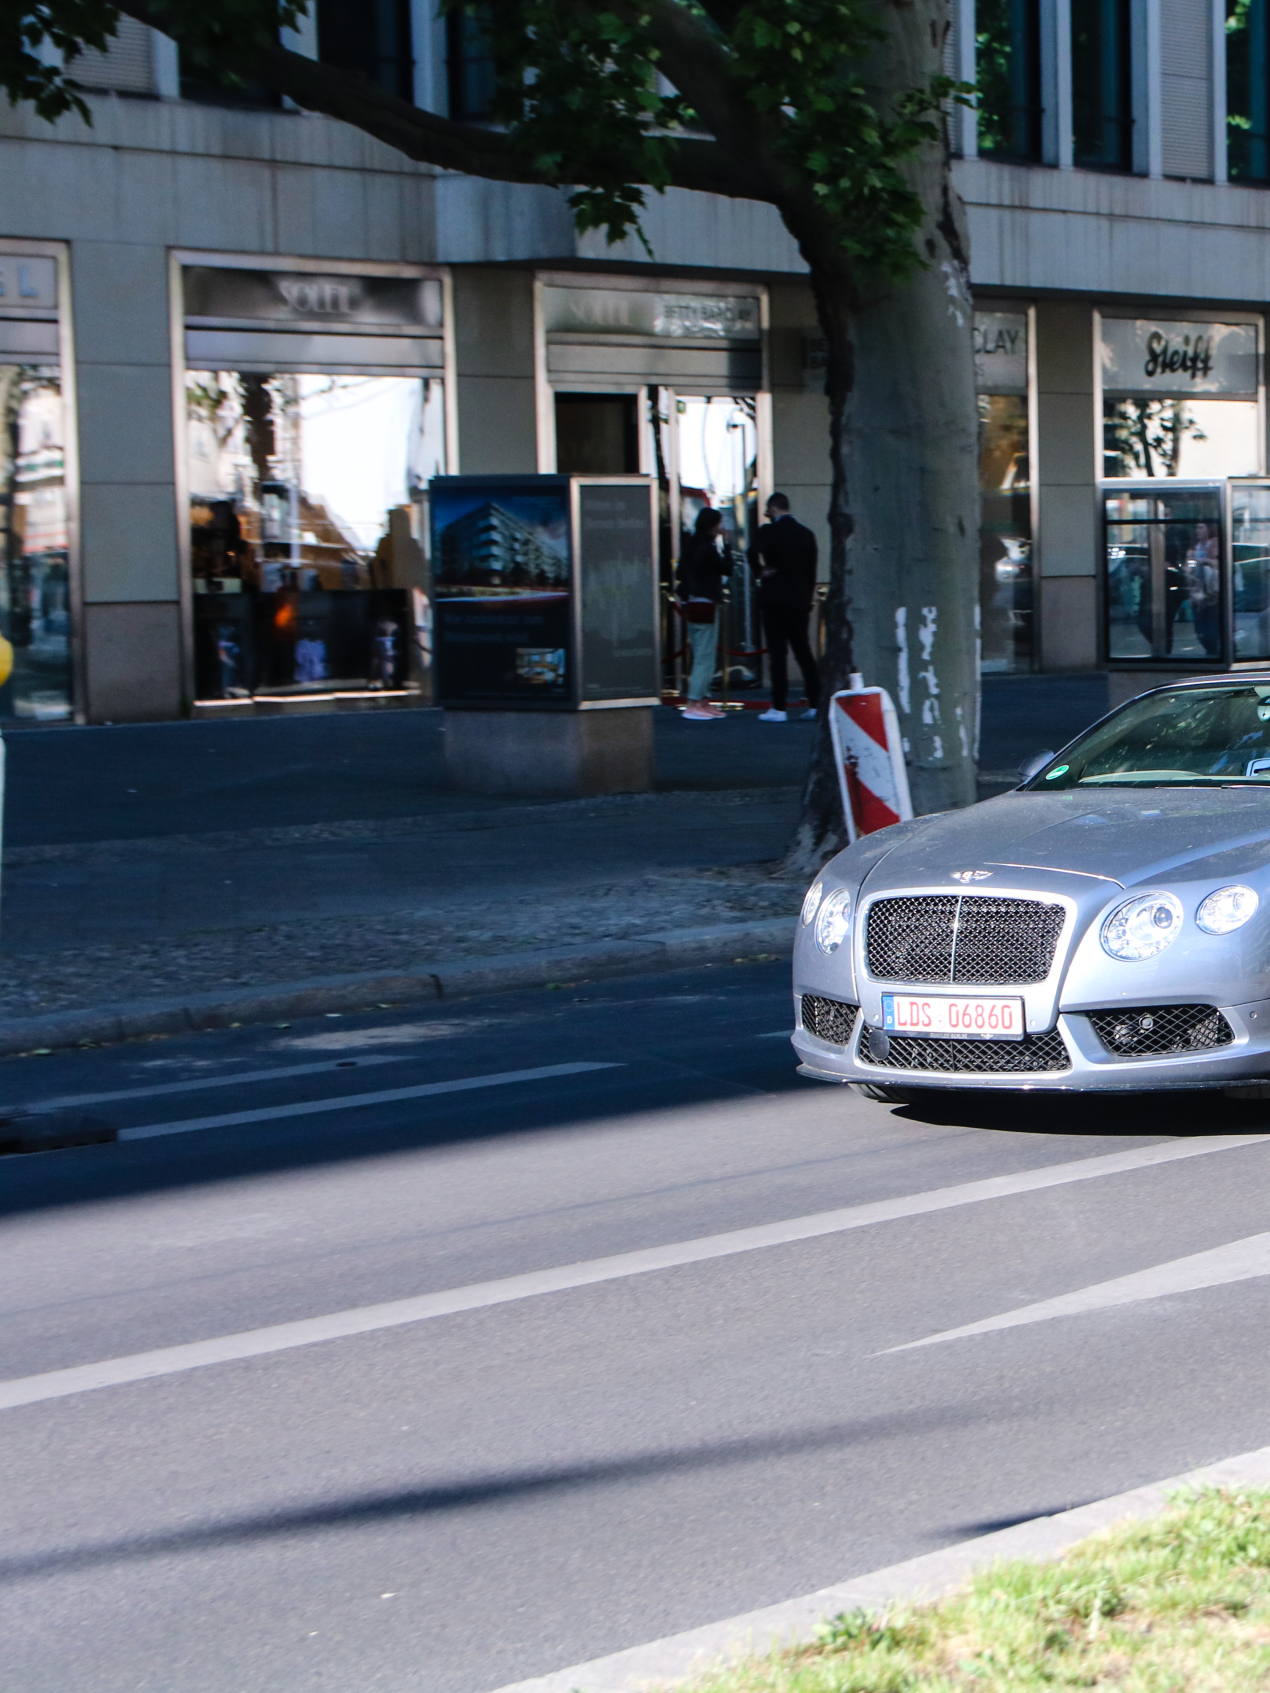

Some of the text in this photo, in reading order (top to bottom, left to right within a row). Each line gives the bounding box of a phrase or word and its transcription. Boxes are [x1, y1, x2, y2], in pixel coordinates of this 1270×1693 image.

[1144, 331, 1213, 380] Steiff
[896, 1001, 932, 1028] LDS
[948, 1003, 1013, 1030] 06860
